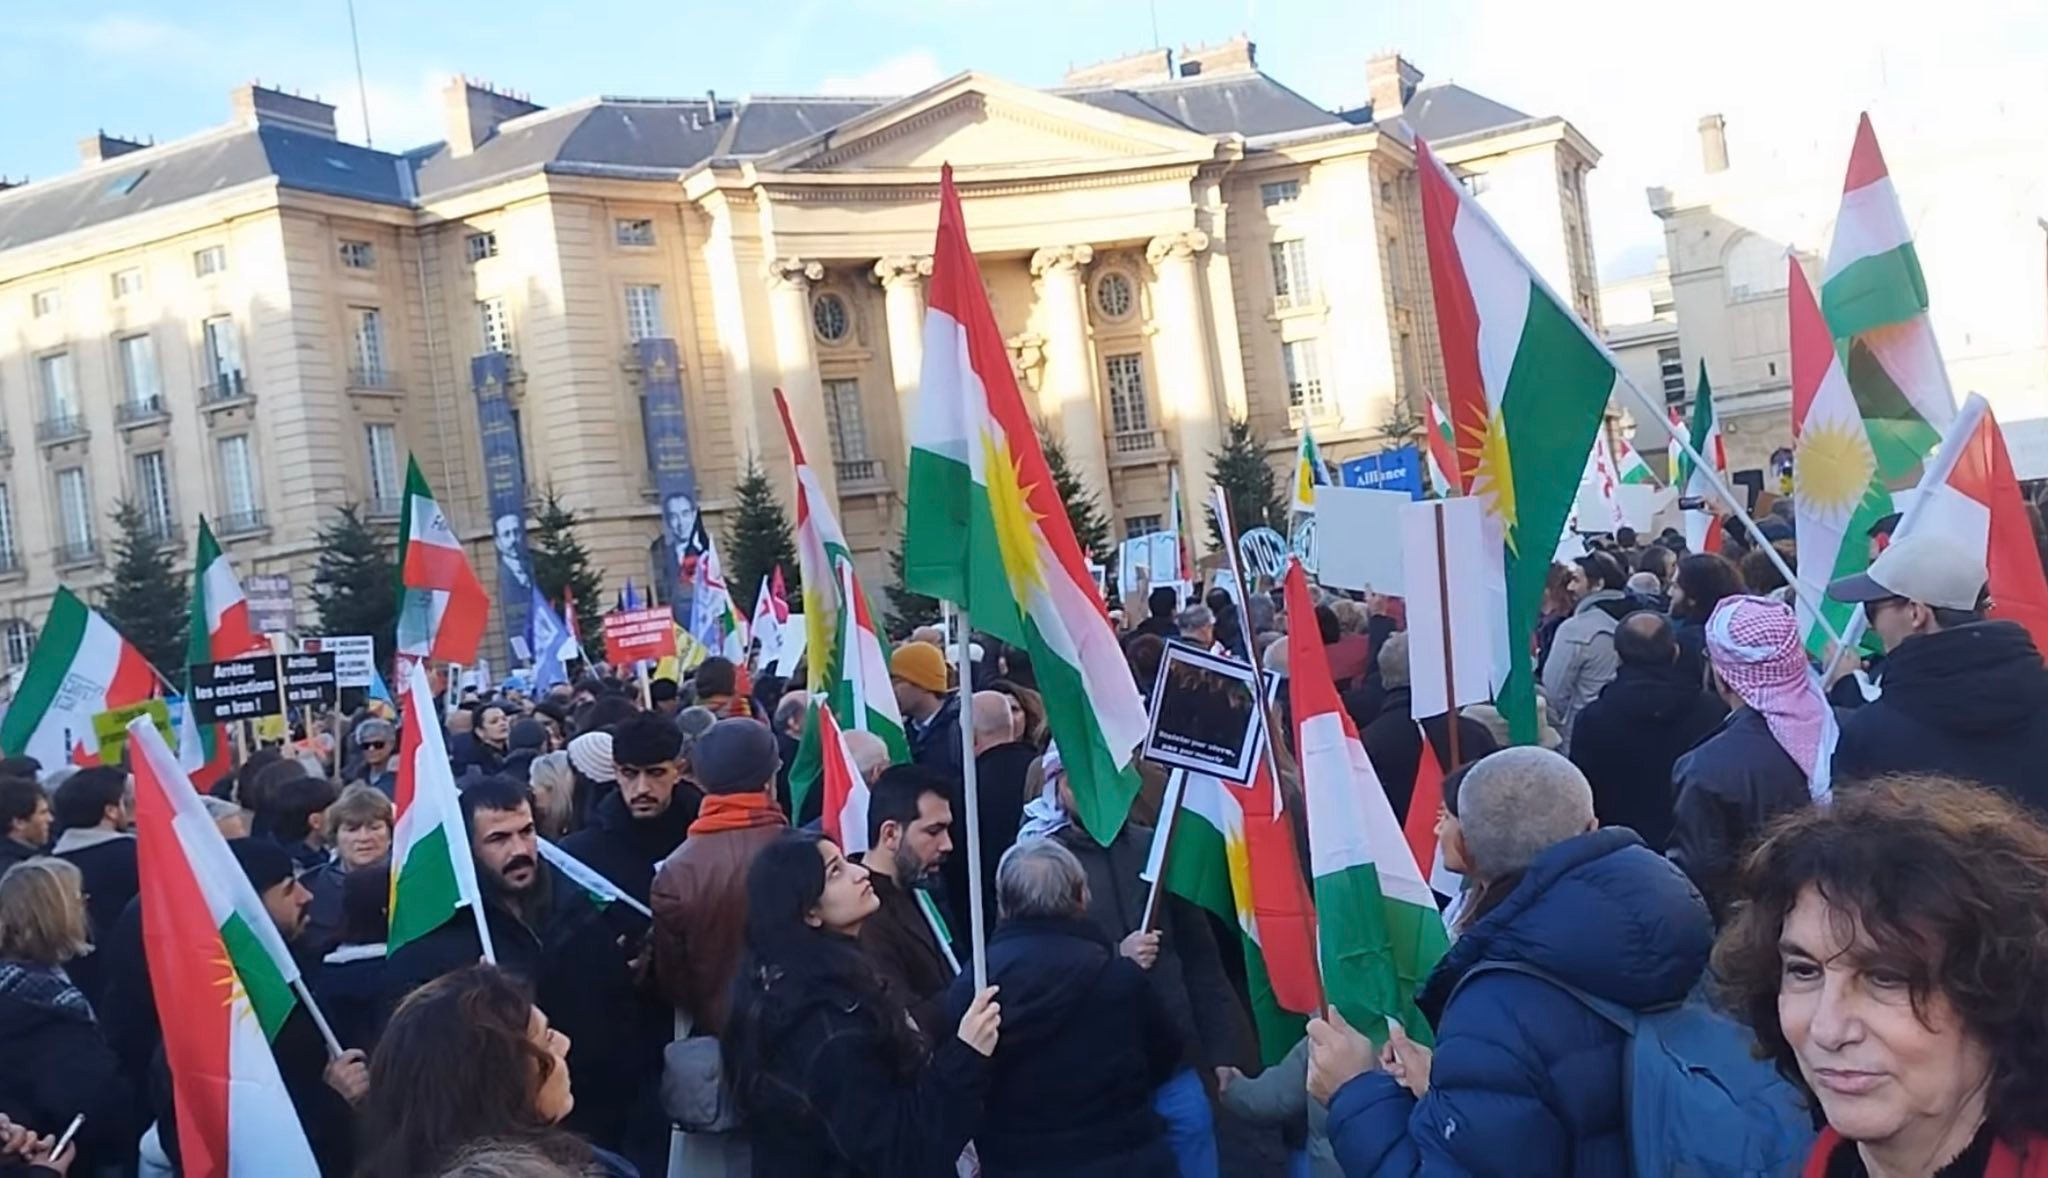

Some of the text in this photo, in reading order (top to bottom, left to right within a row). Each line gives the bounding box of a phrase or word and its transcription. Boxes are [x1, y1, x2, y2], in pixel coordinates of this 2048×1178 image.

[213, 662, 255, 679] Arrêtez
[195, 686, 214, 700] les
[215, 678, 276, 698] exécutions
[214, 704, 231, 717] en
[231, 698, 256, 715] Iran
